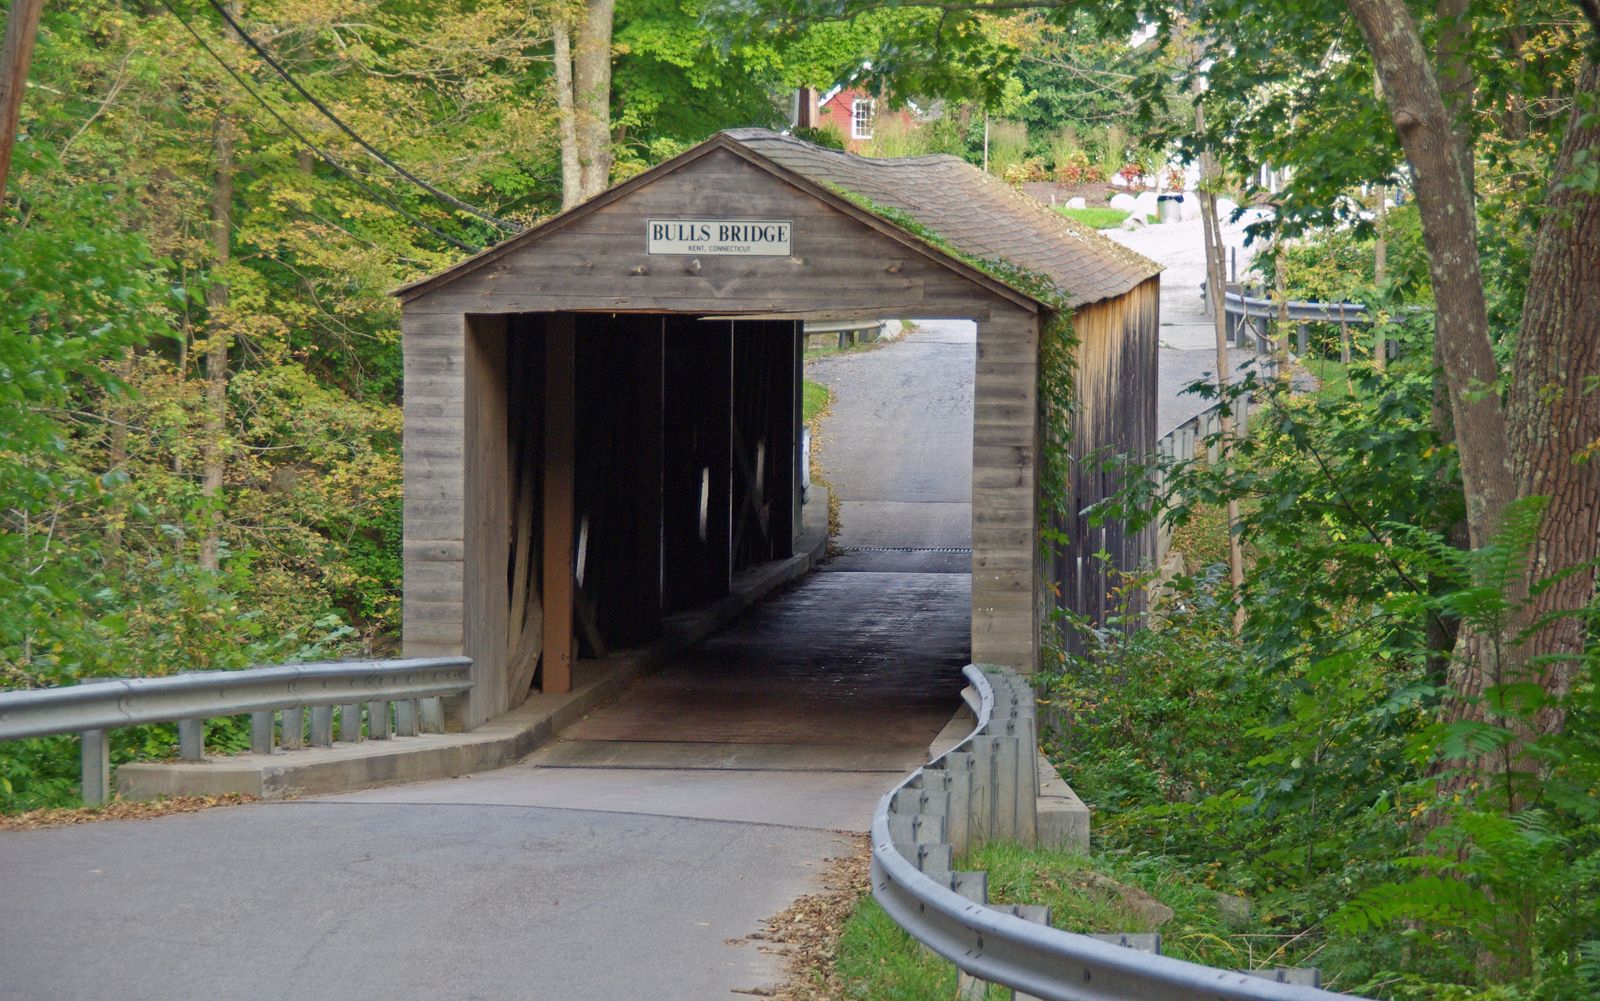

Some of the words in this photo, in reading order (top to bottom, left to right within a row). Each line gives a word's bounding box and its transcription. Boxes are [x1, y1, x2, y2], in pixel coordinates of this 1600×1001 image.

[653, 224, 711, 242] BULLS
[719, 224, 788, 243] BRIDGE
[709, 245, 751, 253] CONNECTICUT
